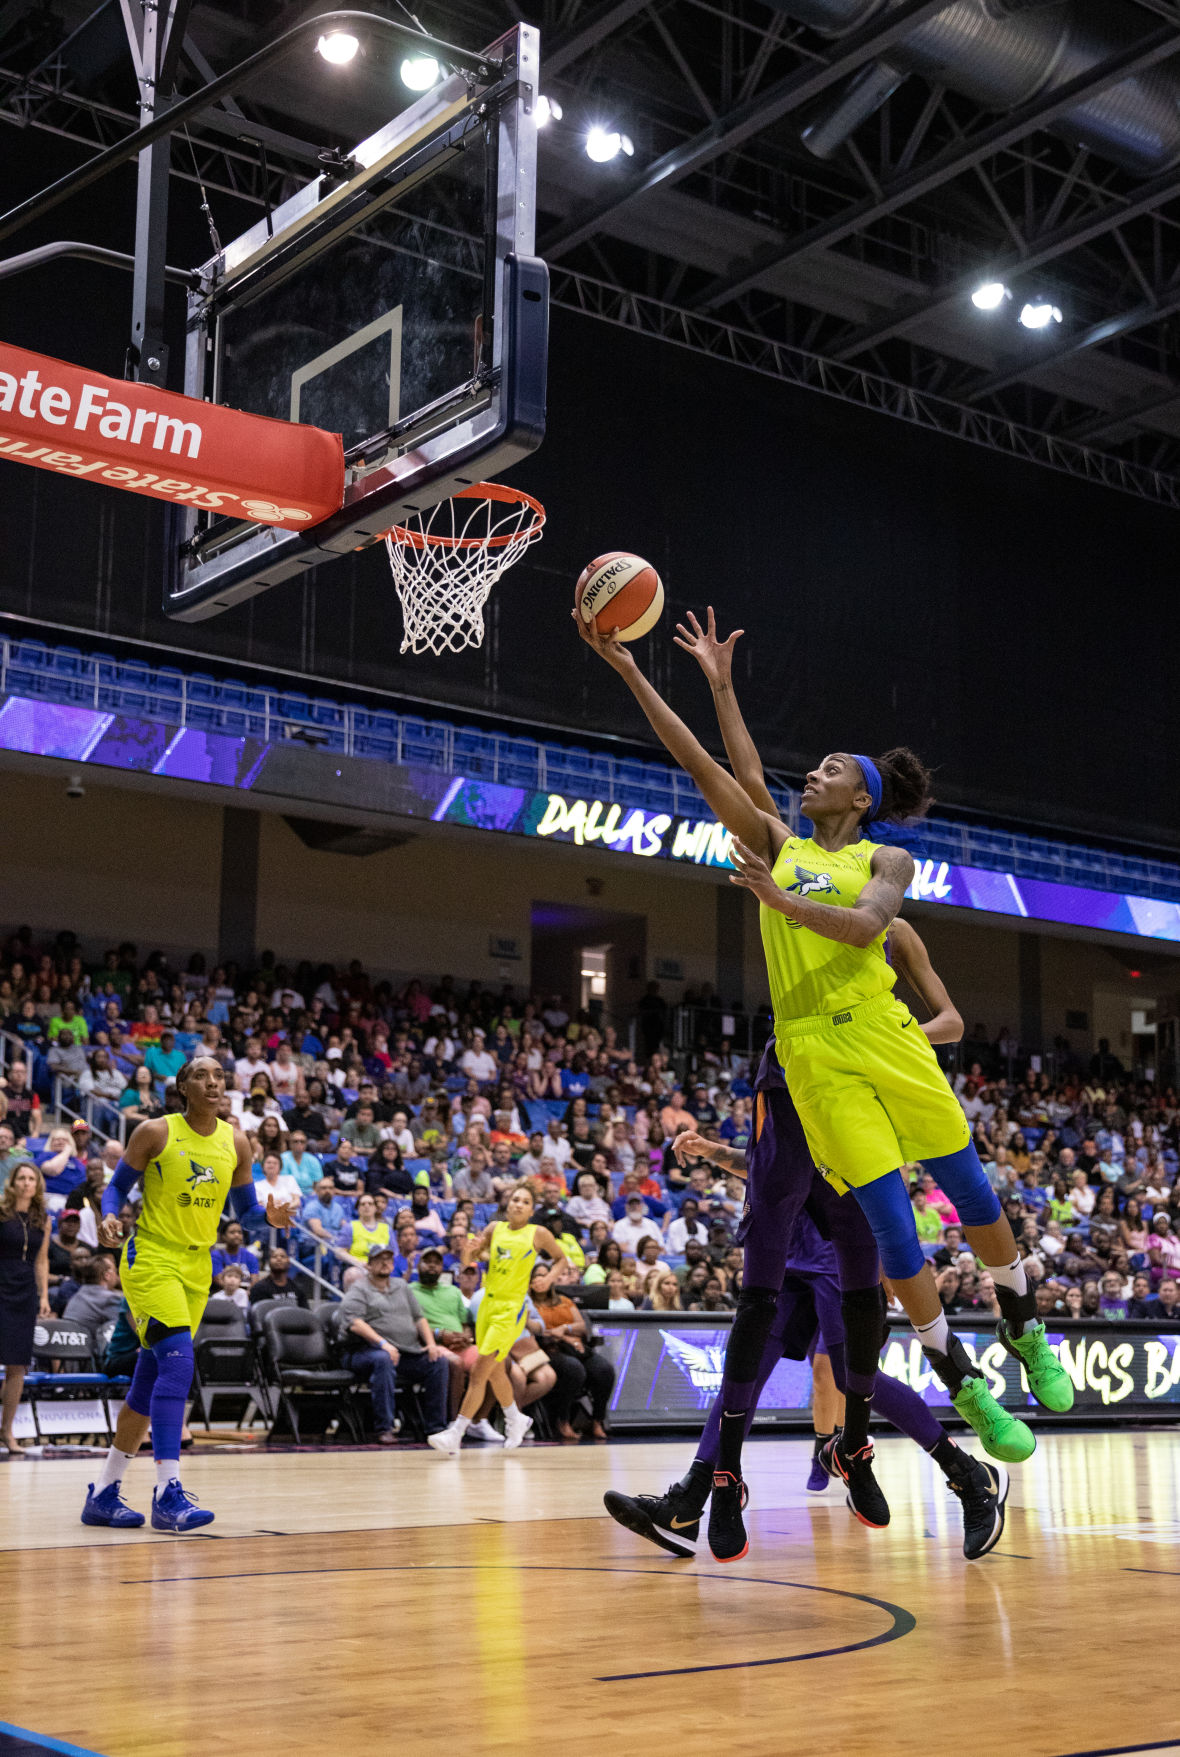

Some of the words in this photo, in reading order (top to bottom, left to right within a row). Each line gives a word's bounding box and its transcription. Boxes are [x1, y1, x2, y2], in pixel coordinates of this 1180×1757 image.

[0, 370, 71, 425] ate
[74, 383, 202, 459] Farm
[102, 465, 240, 507] State
[583, 559, 632, 610] SPALDING
[537, 794, 672, 857] DALLAS
[672, 819, 746, 866] WIN
[193, 1197, 216, 1208] AT&T
[51, 1331, 88, 1346] AT&T
